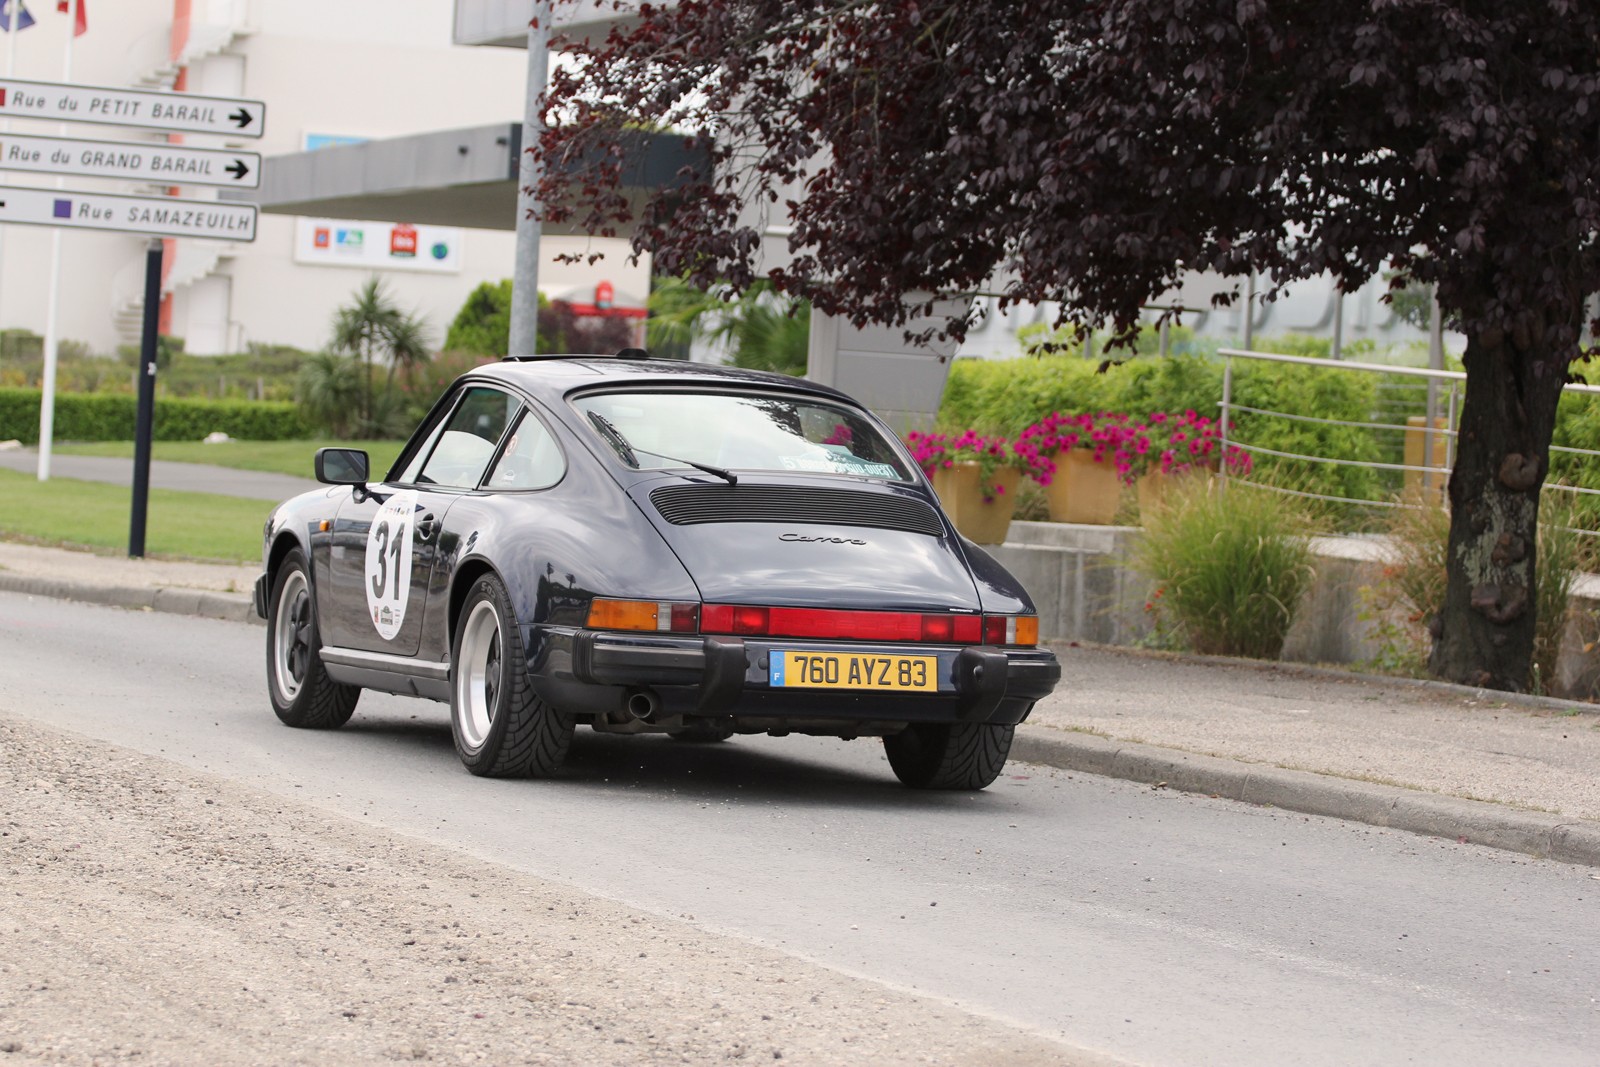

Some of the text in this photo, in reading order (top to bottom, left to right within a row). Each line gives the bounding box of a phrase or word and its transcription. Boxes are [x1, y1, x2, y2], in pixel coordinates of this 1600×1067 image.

[12, 91, 216, 123] Rue du PETIT BARAIL
[9, 145, 212, 175] Rue du GRAND BARAIL
[79, 203, 250, 230] Rue SAMAZEUILH
[779, 533, 867, 546] Carrera
[372, 520, 406, 601] 31
[774, 672, 781, 681] F
[794, 656, 927, 687] 760 AYZ 83
